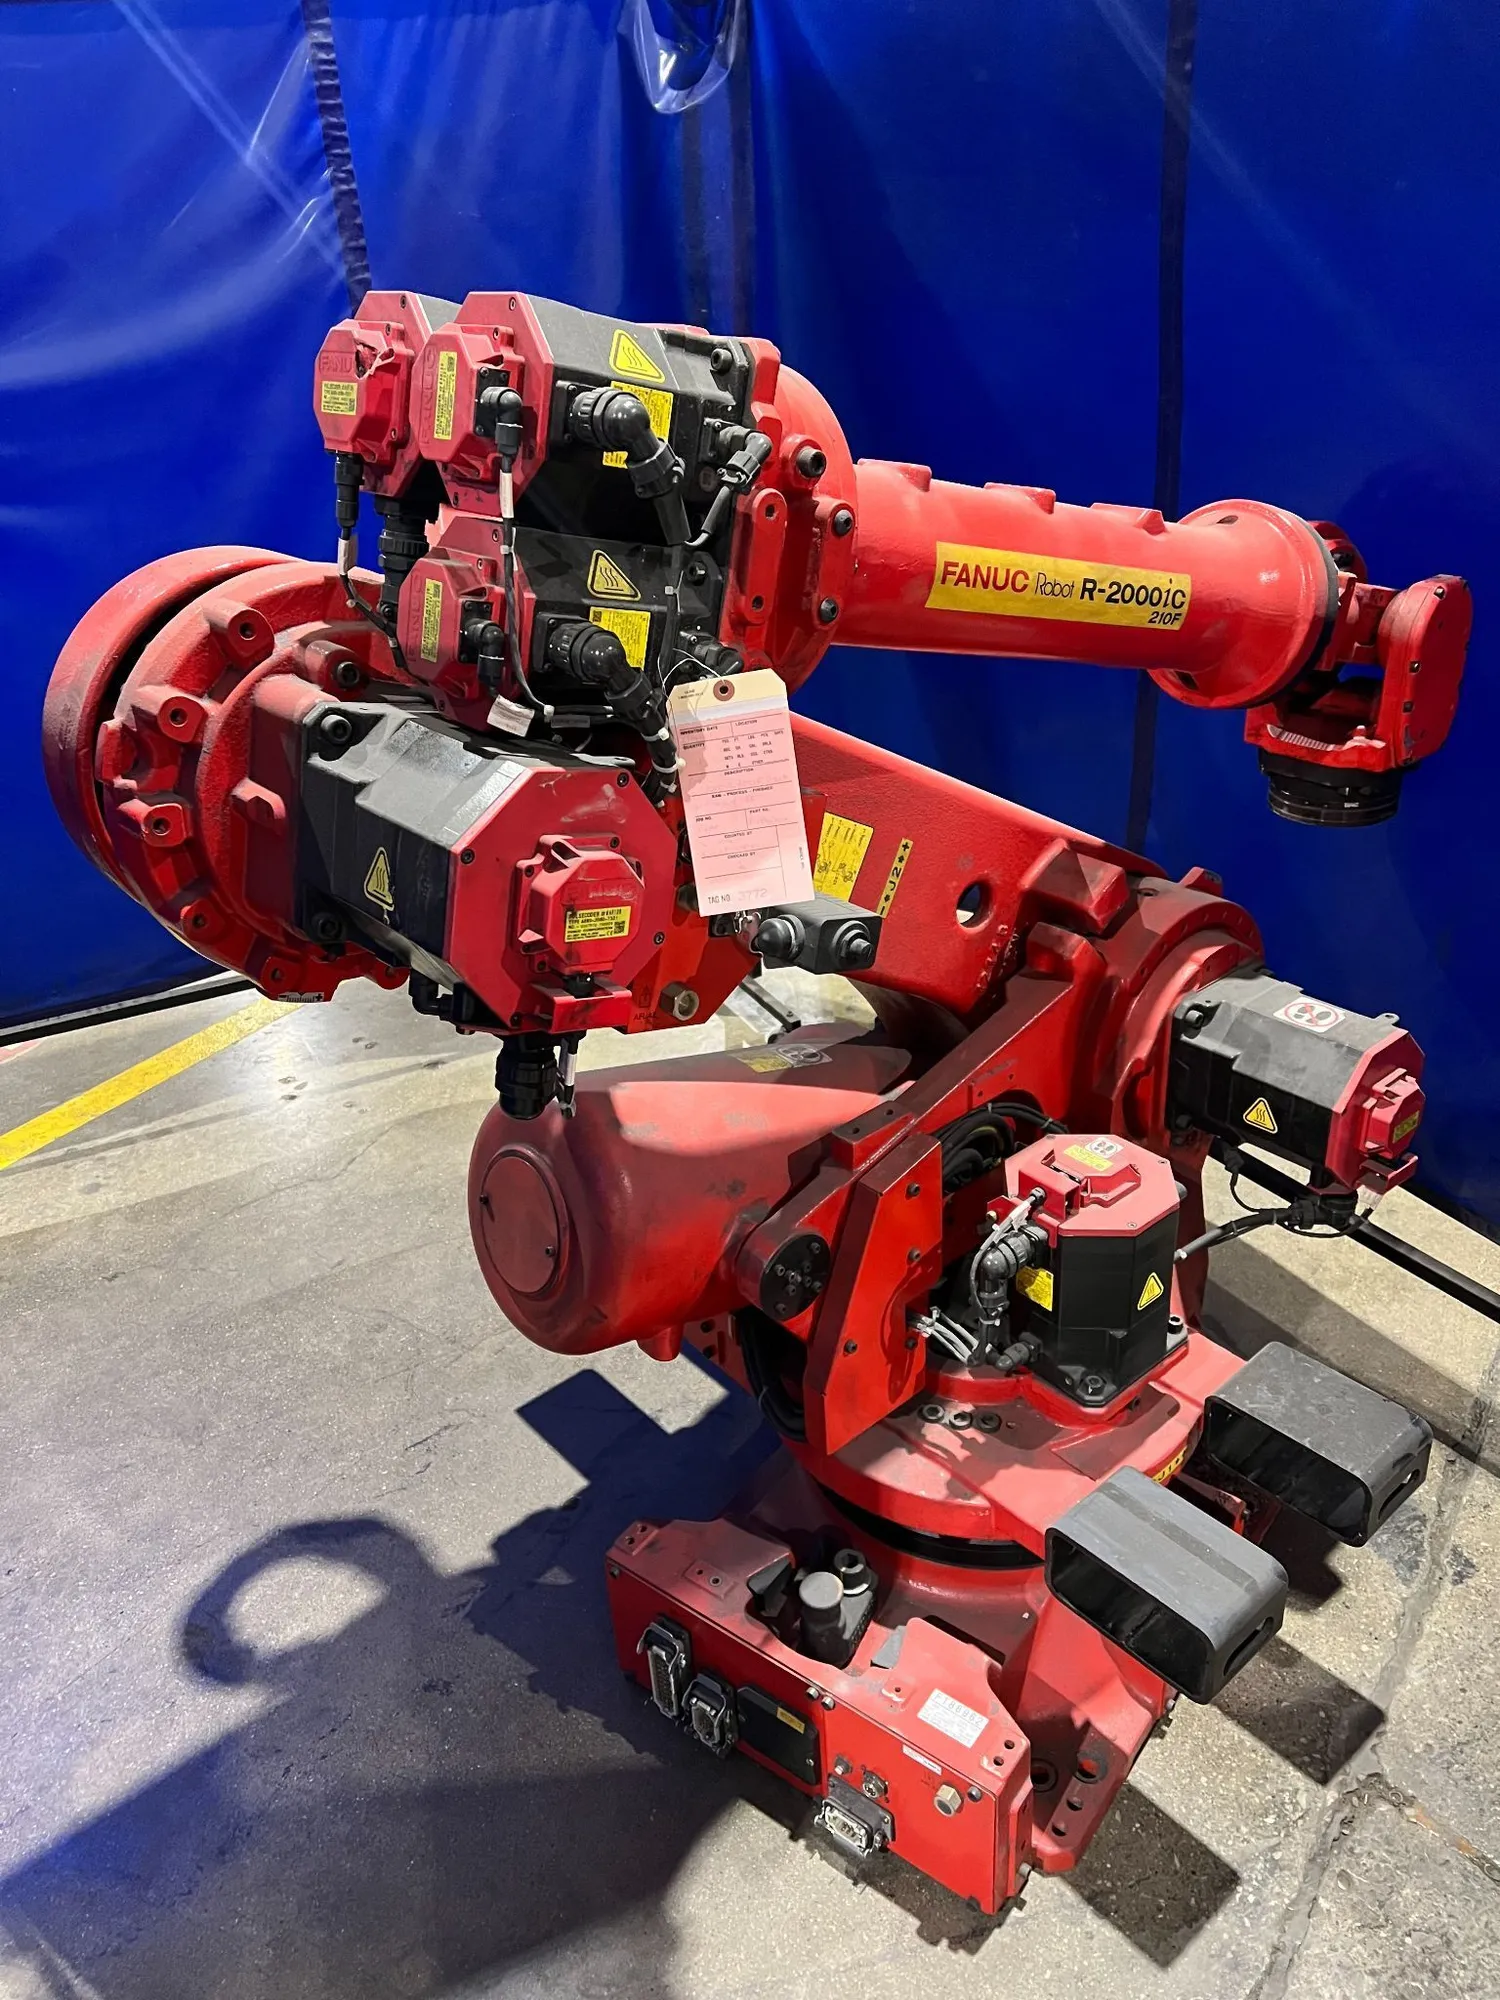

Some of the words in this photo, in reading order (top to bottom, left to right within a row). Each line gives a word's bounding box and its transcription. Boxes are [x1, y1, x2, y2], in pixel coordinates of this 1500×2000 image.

[940, 561, 1029, 593] FANUC
[1034, 572, 1074, 599] Robot
[1080, 577, 1186, 610] R-2000iC
[1148, 611, 1183, 626] 210F
[708, 896, 720, 905] TAG
